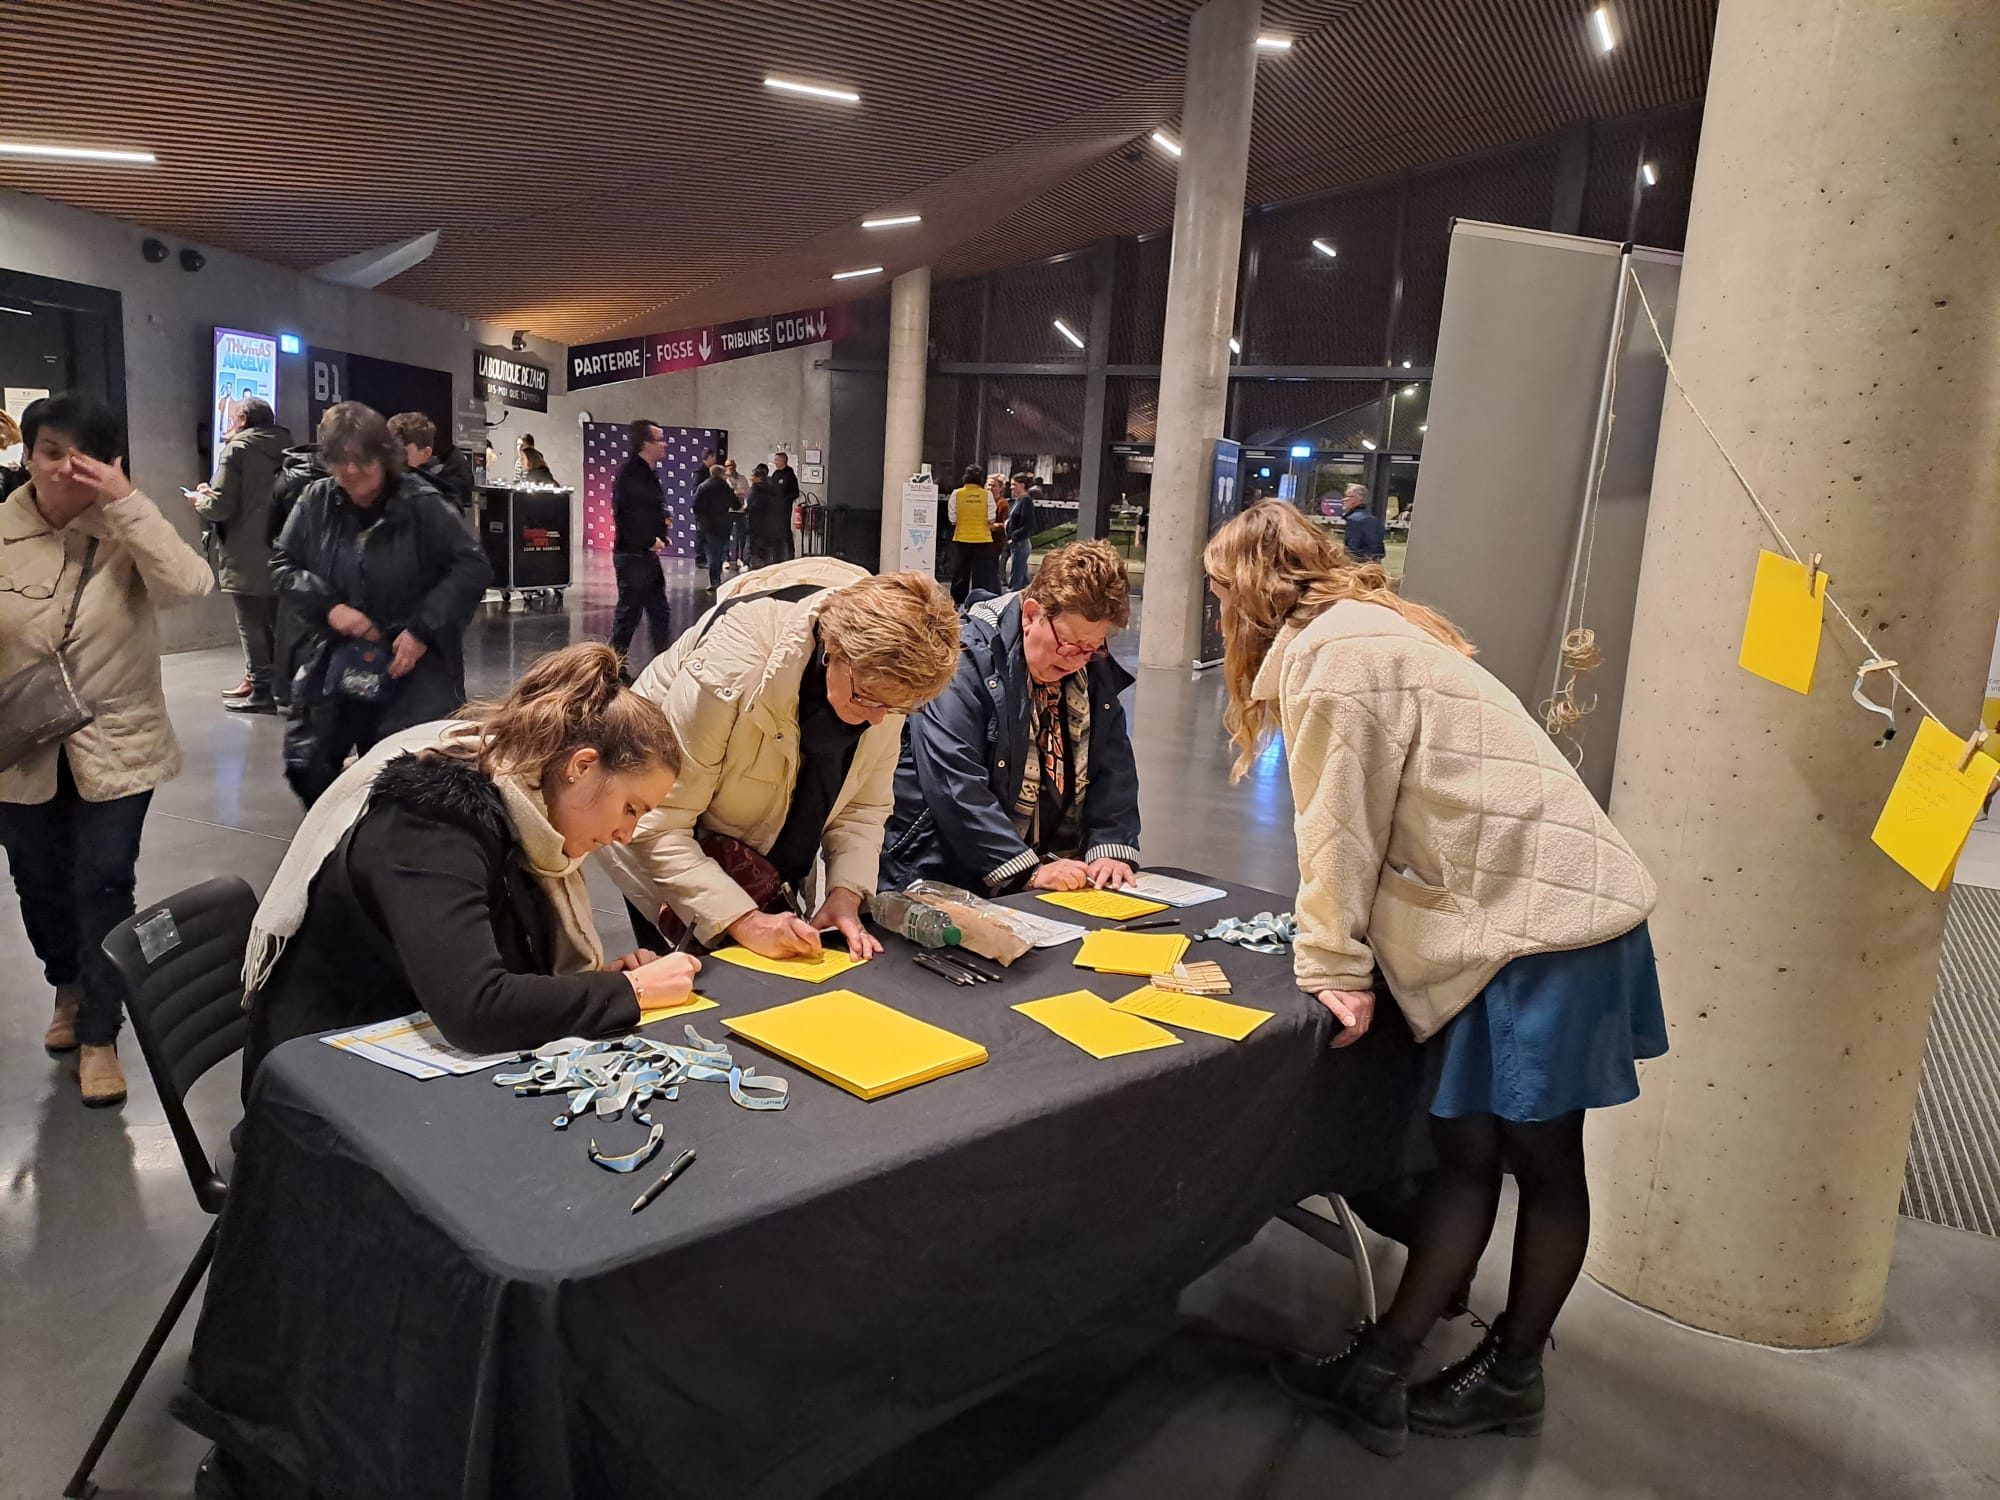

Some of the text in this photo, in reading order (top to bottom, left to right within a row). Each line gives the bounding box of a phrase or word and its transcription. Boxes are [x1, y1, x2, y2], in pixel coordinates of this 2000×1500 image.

[226, 337, 271, 358] THOMAS
[721, 327, 770, 351] TRIBUNES
[223, 353, 271, 373] ANGELVY
[479, 354, 488, 377] LA
[488, 357, 521, 385] BOUTIQUE
[521, 366, 530, 387] DE
[574, 349, 641, 377] PARTERRE
[656, 340, 694, 362] FOSSE
[314, 360, 342, 402] B1
